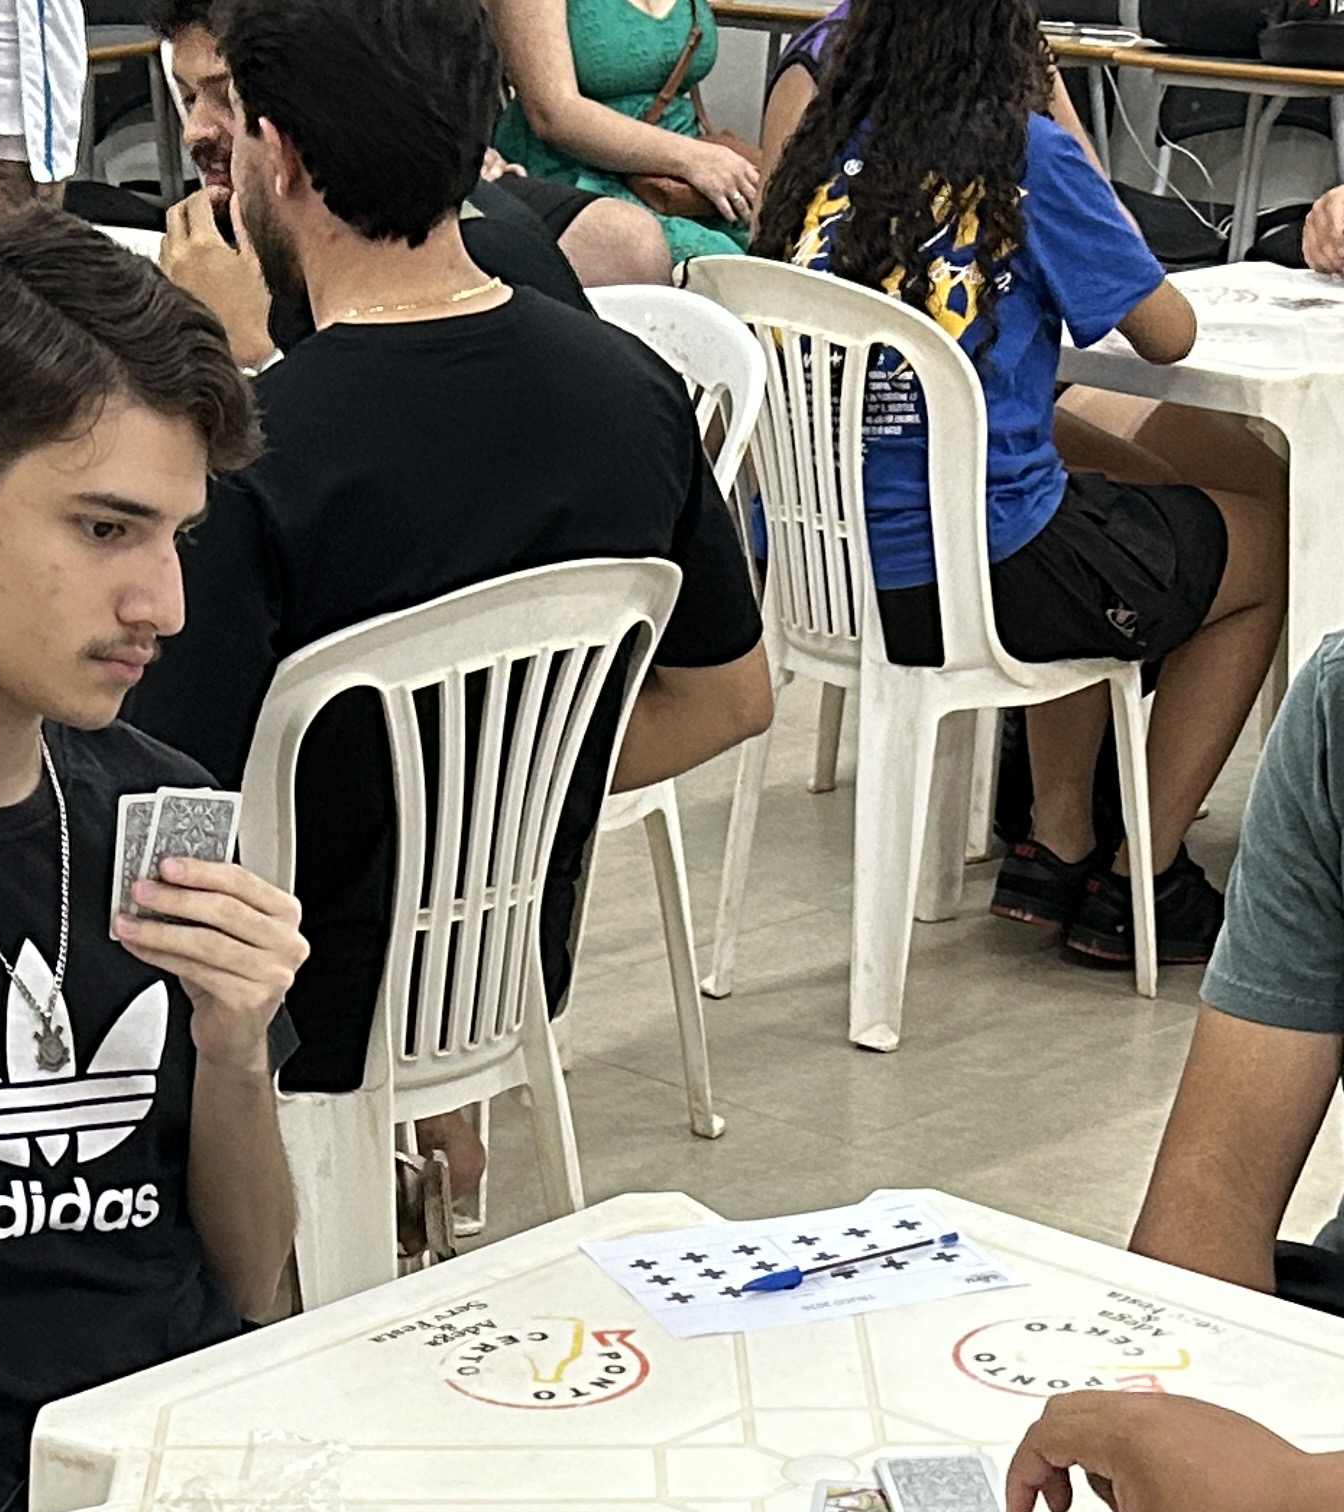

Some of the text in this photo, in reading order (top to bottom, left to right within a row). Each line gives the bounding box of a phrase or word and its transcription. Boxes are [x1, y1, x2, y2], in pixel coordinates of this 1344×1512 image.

[456, 1330, 549, 1377] CERTO
[1024, 1321, 1145, 1357] CERTO
[532, 1351, 626, 1400] PONTO
[972, 1352, 1104, 1389] PONTO
